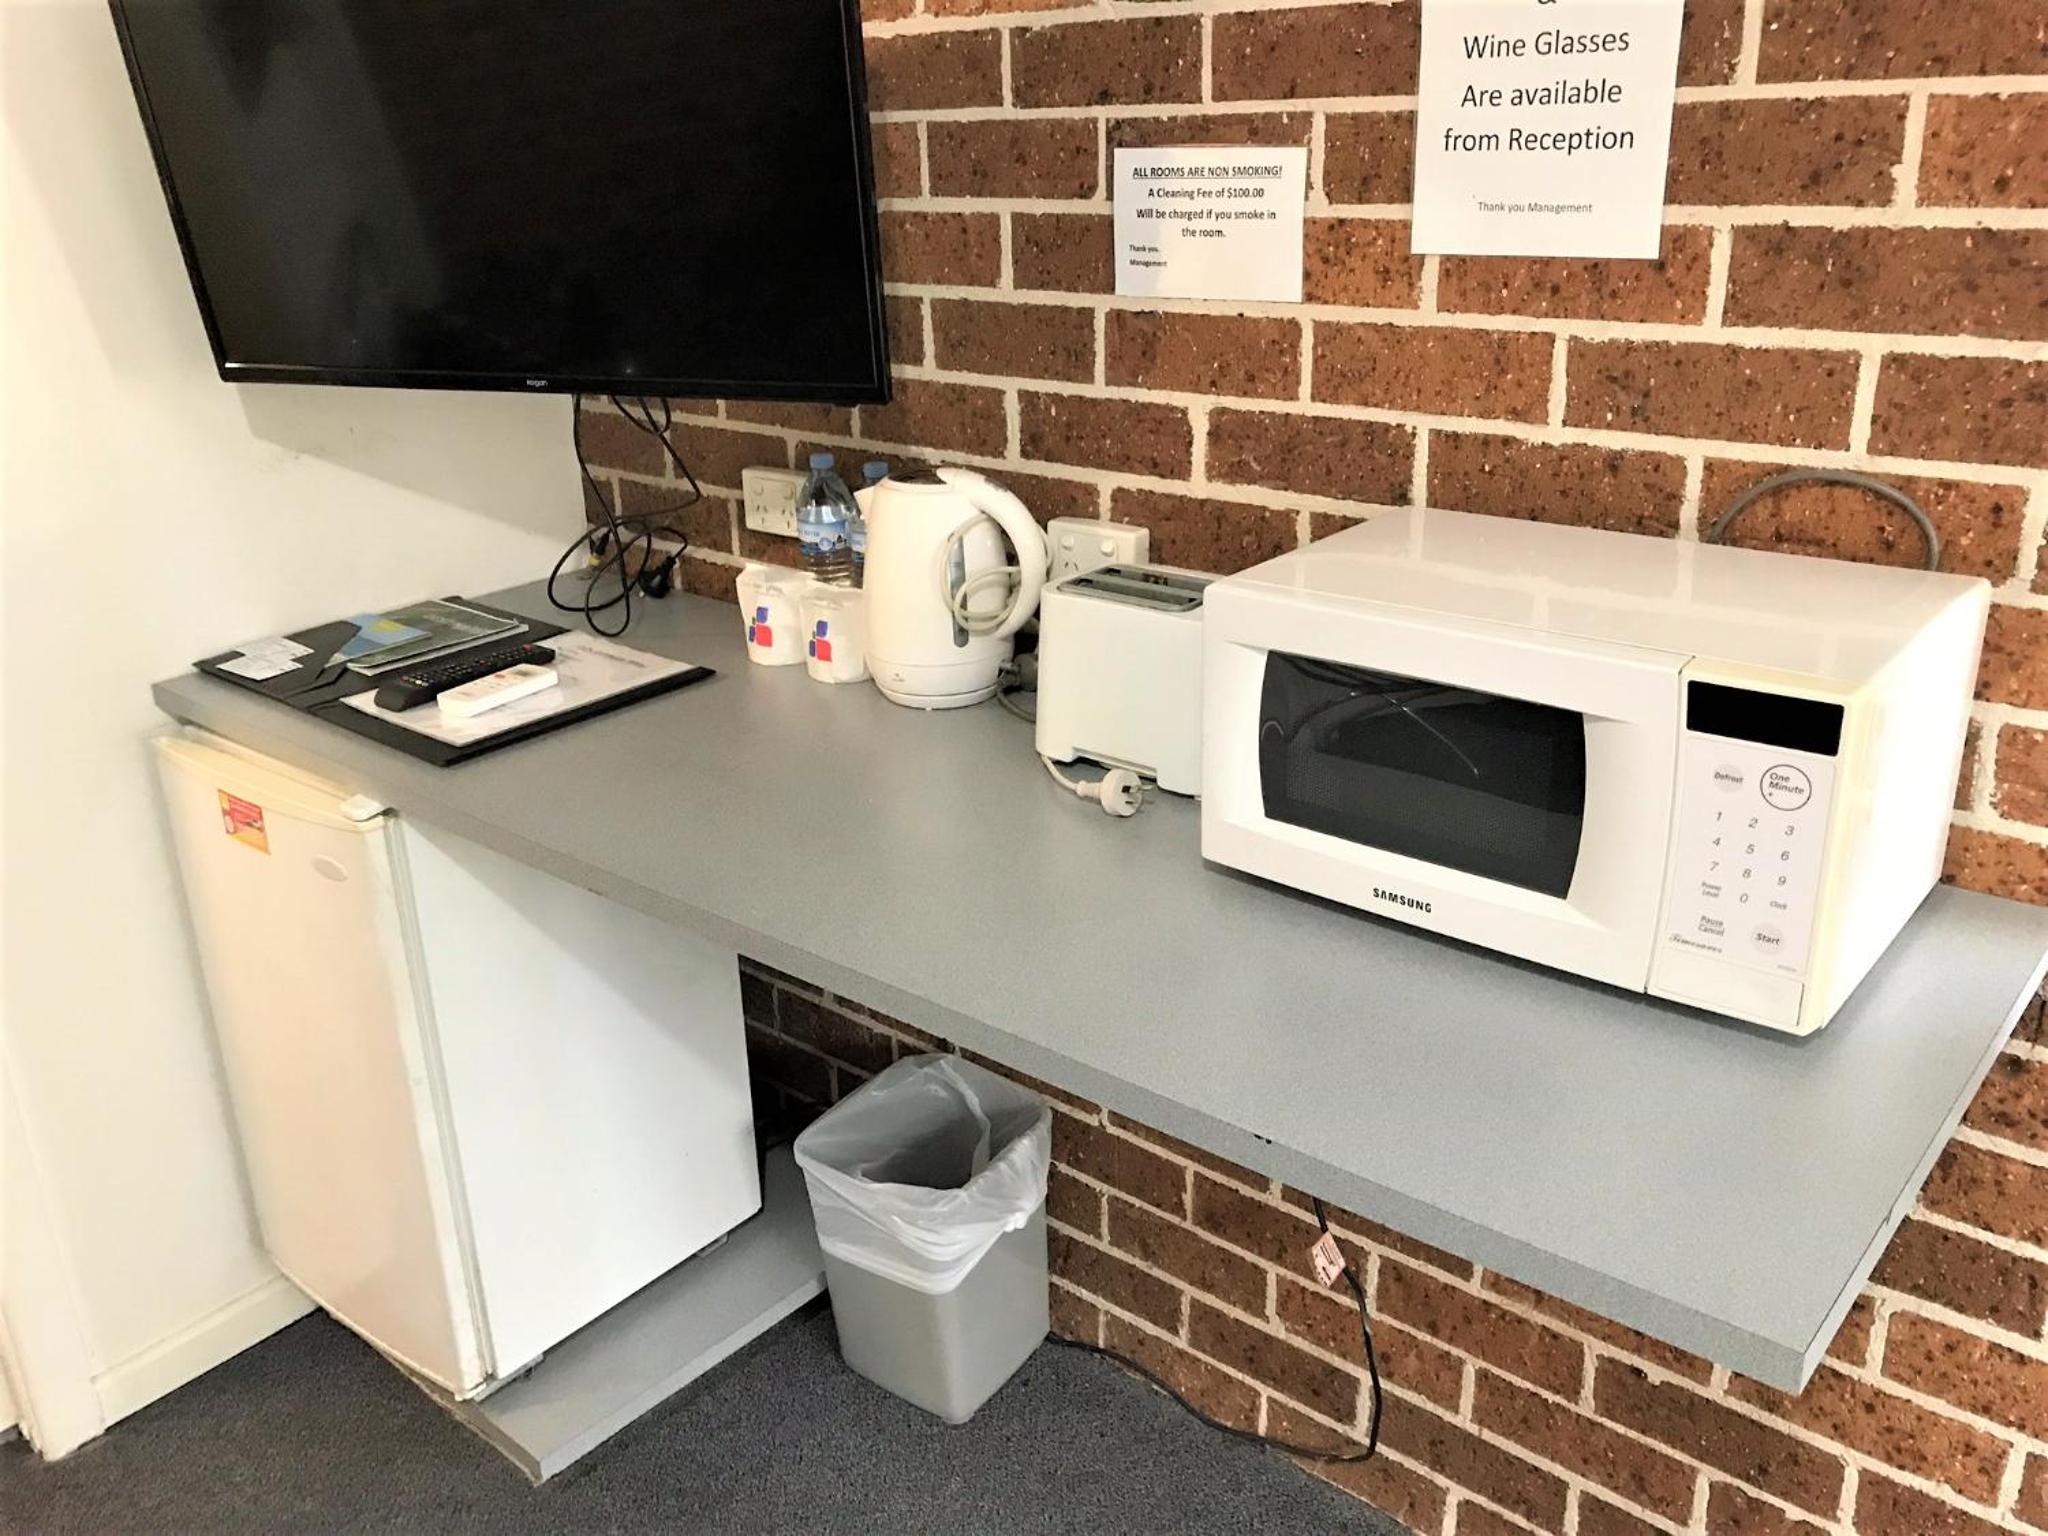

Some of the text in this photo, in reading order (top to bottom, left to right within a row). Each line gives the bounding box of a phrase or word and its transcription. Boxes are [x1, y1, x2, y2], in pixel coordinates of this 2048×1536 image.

[1463, 29, 1630, 59] Wine Glasses
[1461, 78, 1623, 108] Are available
[1444, 125, 1634, 156] from Reception
[1132, 165, 1282, 177] ALL ROOMS ARE NON SMOKING!
[1147, 187, 1265, 200] A Cleaning Fee of $100.00
[1477, 201, 1593, 215] Thank you Management
[1136, 208, 1276, 222] Will be charged if you smoke in
[1182, 227, 1226, 238] the room.
[1129, 243, 1146, 252] Thank
[1129, 258, 1168, 268] Management
[1714, 771, 1744, 784] Defrost
[1769, 772, 1791, 783] One
[1768, 780, 1805, 795] Minute
[1716, 811, 1722, 821] 1
[1748, 817, 1759, 829] 2
[1784, 825, 1795, 836] 3
[1712, 837, 1721, 847] 4
[1745, 843, 1755, 855] 5
[1781, 851, 1790, 862] 6
[1709, 860, 1719, 871] 7
[1742, 867, 1752, 879] 8
[1777, 875, 1787, 886] 9
[1372, 887, 1432, 913] SAMSUNG
[1739, 892, 1749, 904] 0
[1700, 915, 1724, 927] Pause
[1697, 923, 1725, 937] Cancel
[1755, 932, 1780, 946] Start
